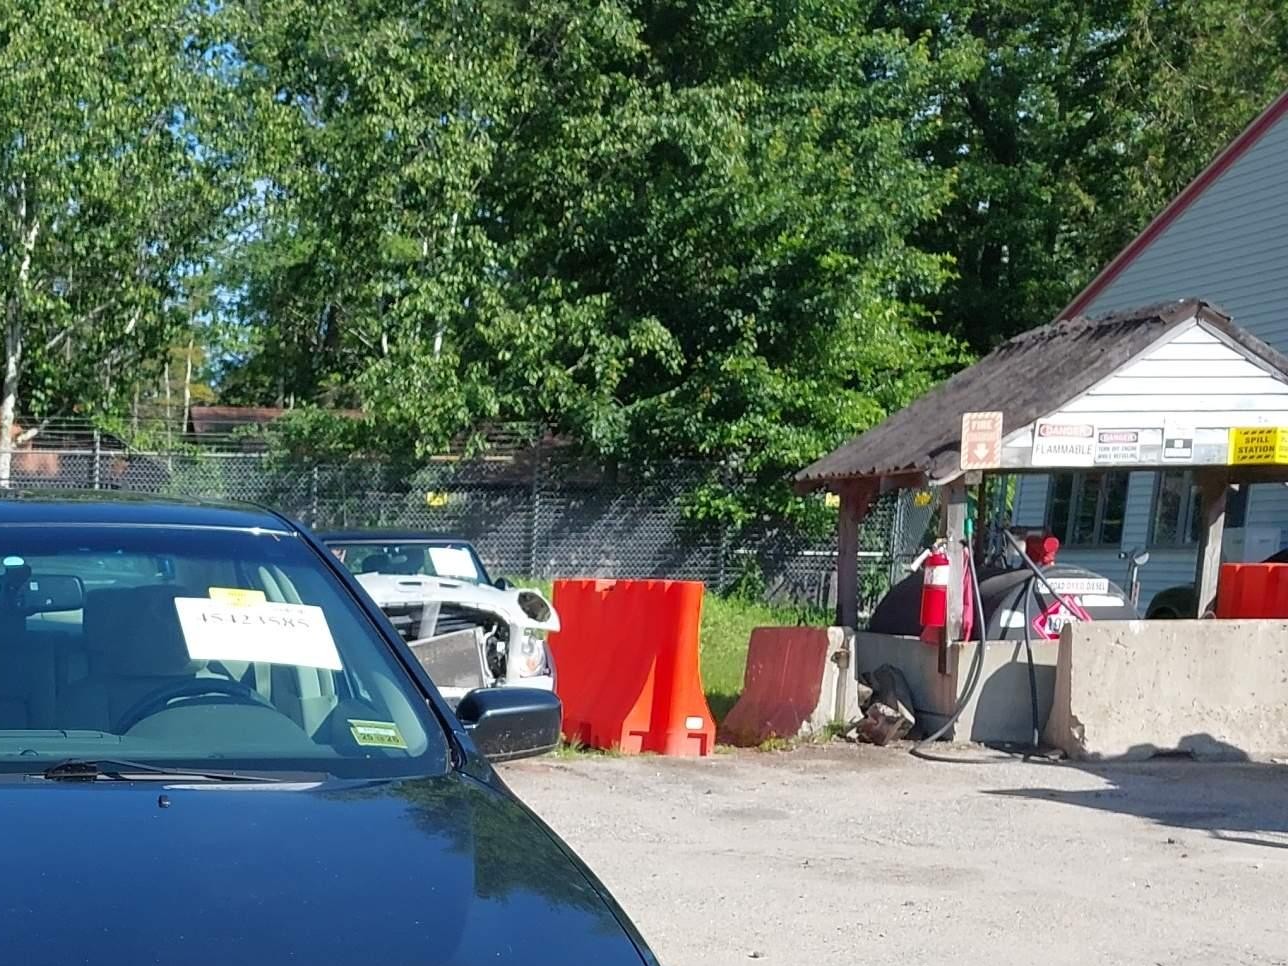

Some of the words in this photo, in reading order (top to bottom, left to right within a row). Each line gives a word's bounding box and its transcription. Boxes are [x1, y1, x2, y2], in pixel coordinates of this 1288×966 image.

[1045, 425, 1086, 435] DANGER
[1103, 433, 1131, 441] DANGER
[1245, 436, 1269, 444] SPILL
[1035, 443, 1093, 456] FLAMMABLE
[1238, 445, 1275, 454] STATION
